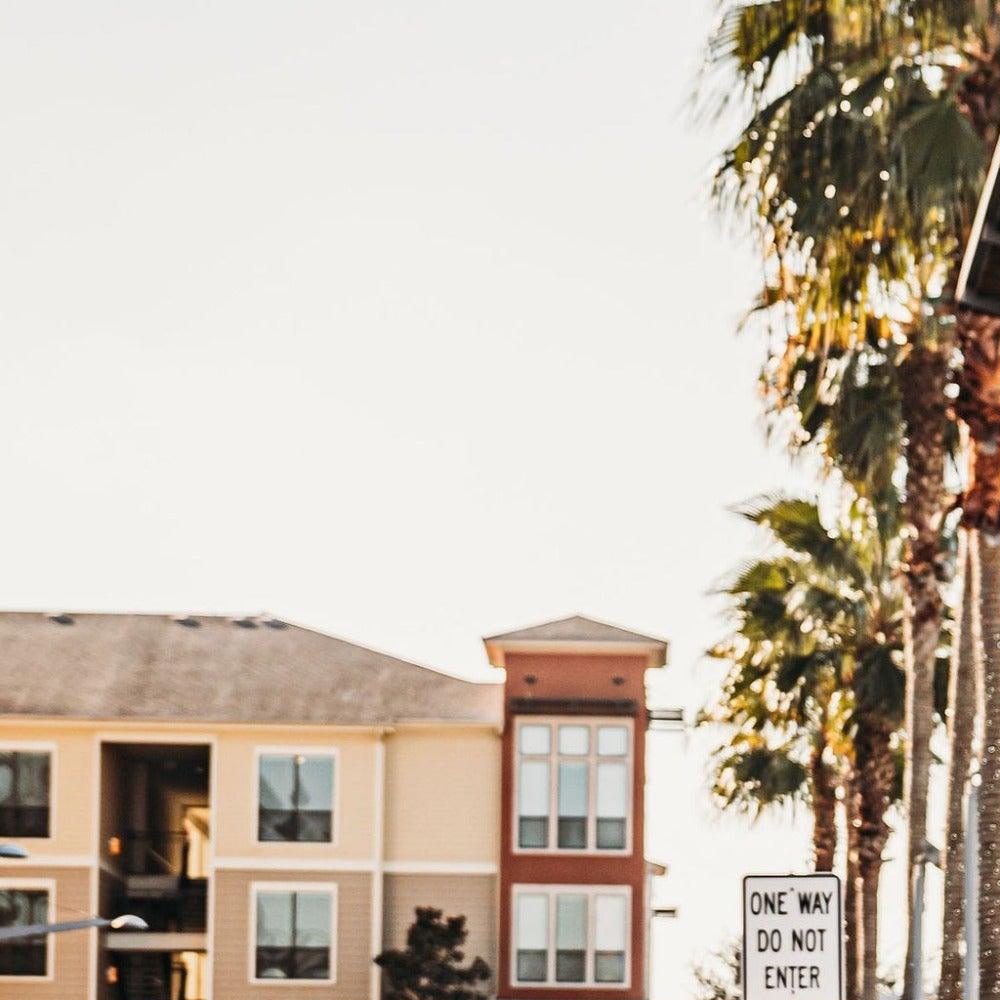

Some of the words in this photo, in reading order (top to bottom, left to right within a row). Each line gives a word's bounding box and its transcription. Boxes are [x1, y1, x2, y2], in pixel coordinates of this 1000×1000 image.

[750, 891, 788, 915] ONE
[798, 892, 833, 915] WAY
[757, 928, 782, 952] DO
[792, 928, 826, 952] NOT
[765, 965, 820, 989] ENTER
